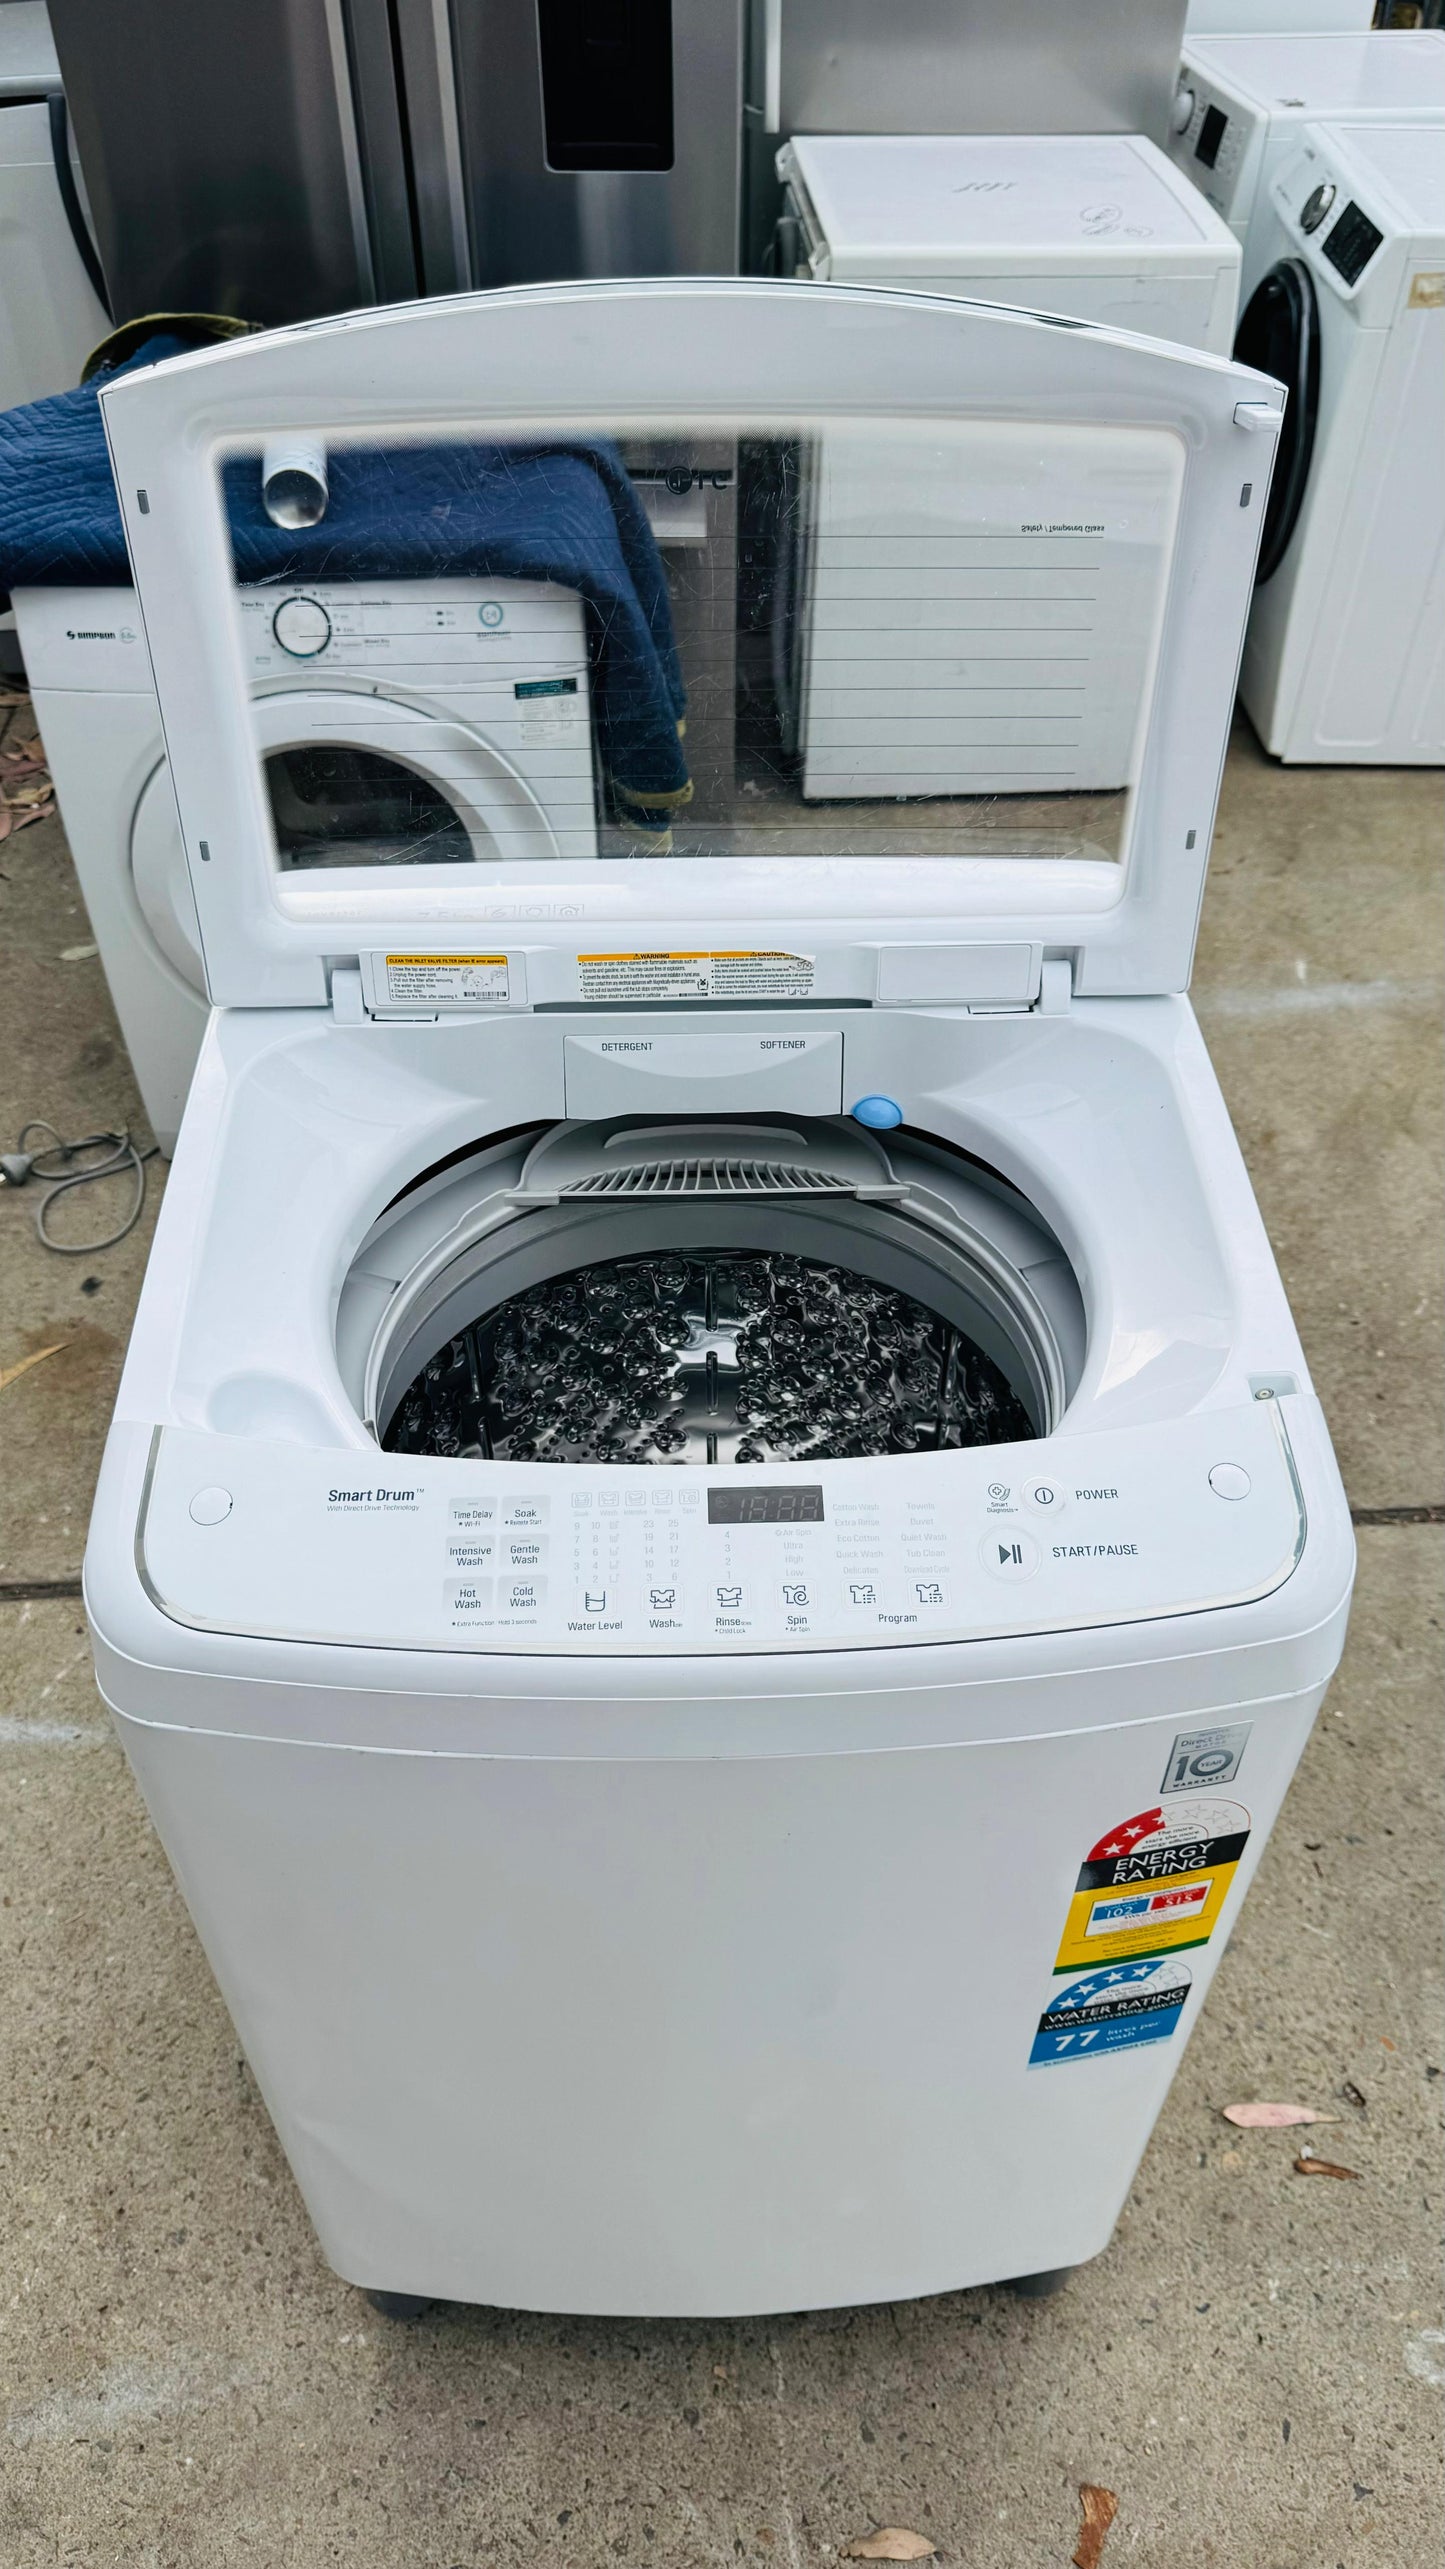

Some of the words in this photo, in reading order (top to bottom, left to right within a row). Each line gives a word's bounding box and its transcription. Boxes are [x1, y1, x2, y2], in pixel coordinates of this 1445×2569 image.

[601, 1042, 654, 1051] DETERGENT
[760, 1040, 806, 1049] SOFTENER
[328, 1490, 372, 1502] Smart
[1075, 1489, 1118, 1500] POWER
[472, 1510, 493, 1519] Delay
[514, 1509, 536, 1518] Soak
[450, 1547, 492, 1556] Intensive
[510, 1545, 540, 1554] Gentle
[1052, 1544, 1139, 1558] START/PAUSE
[456, 1557, 483, 1566] Wash
[512, 1555, 538, 1564] Wash
[460, 1589, 476, 1598] Hot
[513, 1587, 533, 1596] Cold
[454, 1600, 481, 1608] Wash
[510, 1598, 536, 1607] Wash
[649, 1619, 675, 1628] Wash
[716, 1617, 741, 1626] Rinse
[787, 1615, 807, 1625] Spin
[878, 1614, 917, 1624] Program
[568, 1622, 595, 1631] Water
[598, 1621, 623, 1630] Level
[1181, 1736, 1212, 1747] Direct
[1175, 1749, 1234, 1781] 10
[1173, 1775, 1226, 1788] WARRANTY
[1115, 1841, 1215, 1871] ENERGY
[1112, 1856, 1207, 1884] RATING
[1106, 1906, 1133, 1918] 102
[1048, 2005, 1111, 2023] WATER
[1117, 1988, 1185, 2011] RATING
[1055, 2030, 1100, 2051] 77
